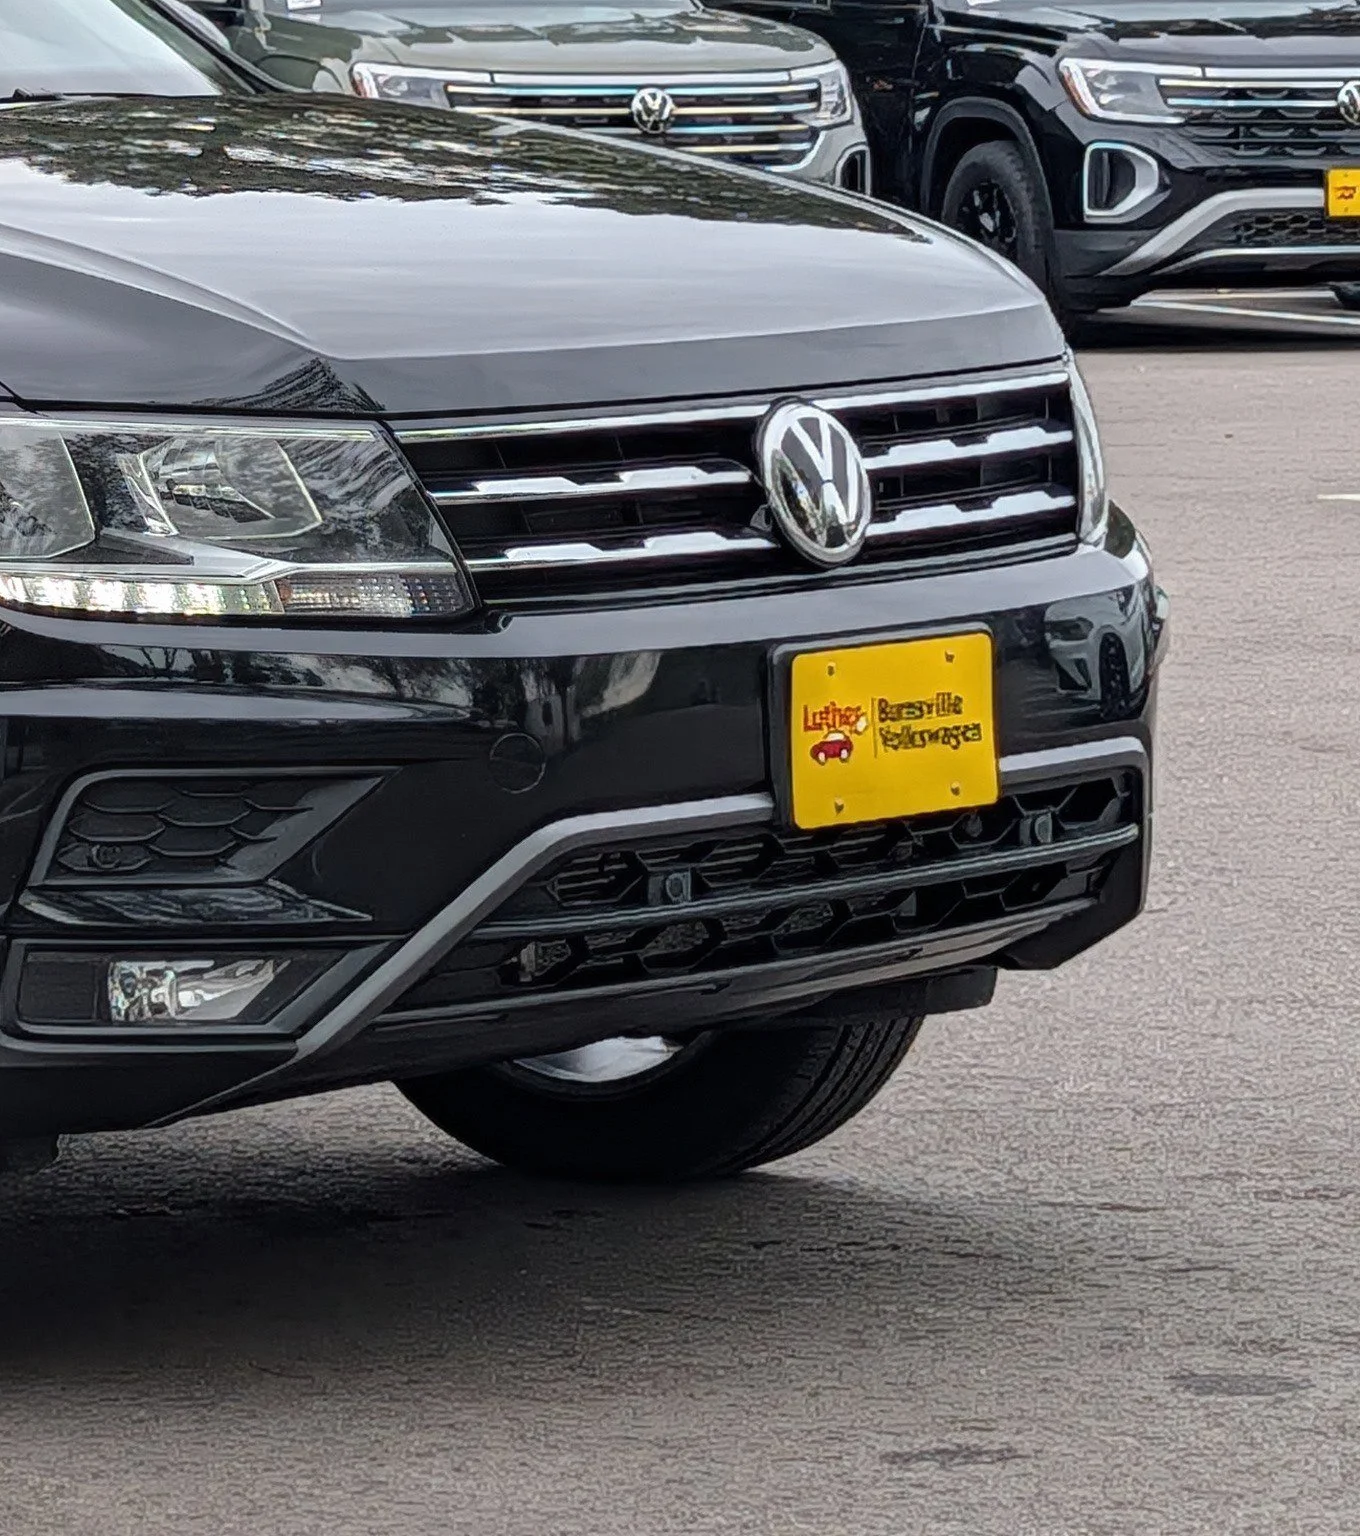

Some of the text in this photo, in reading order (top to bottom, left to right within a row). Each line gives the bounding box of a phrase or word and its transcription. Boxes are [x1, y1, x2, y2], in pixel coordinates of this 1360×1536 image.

[802, 701, 863, 732] Luther
[878, 691, 962, 723] Burnsville
[880, 722, 982, 751] Volkswagen
